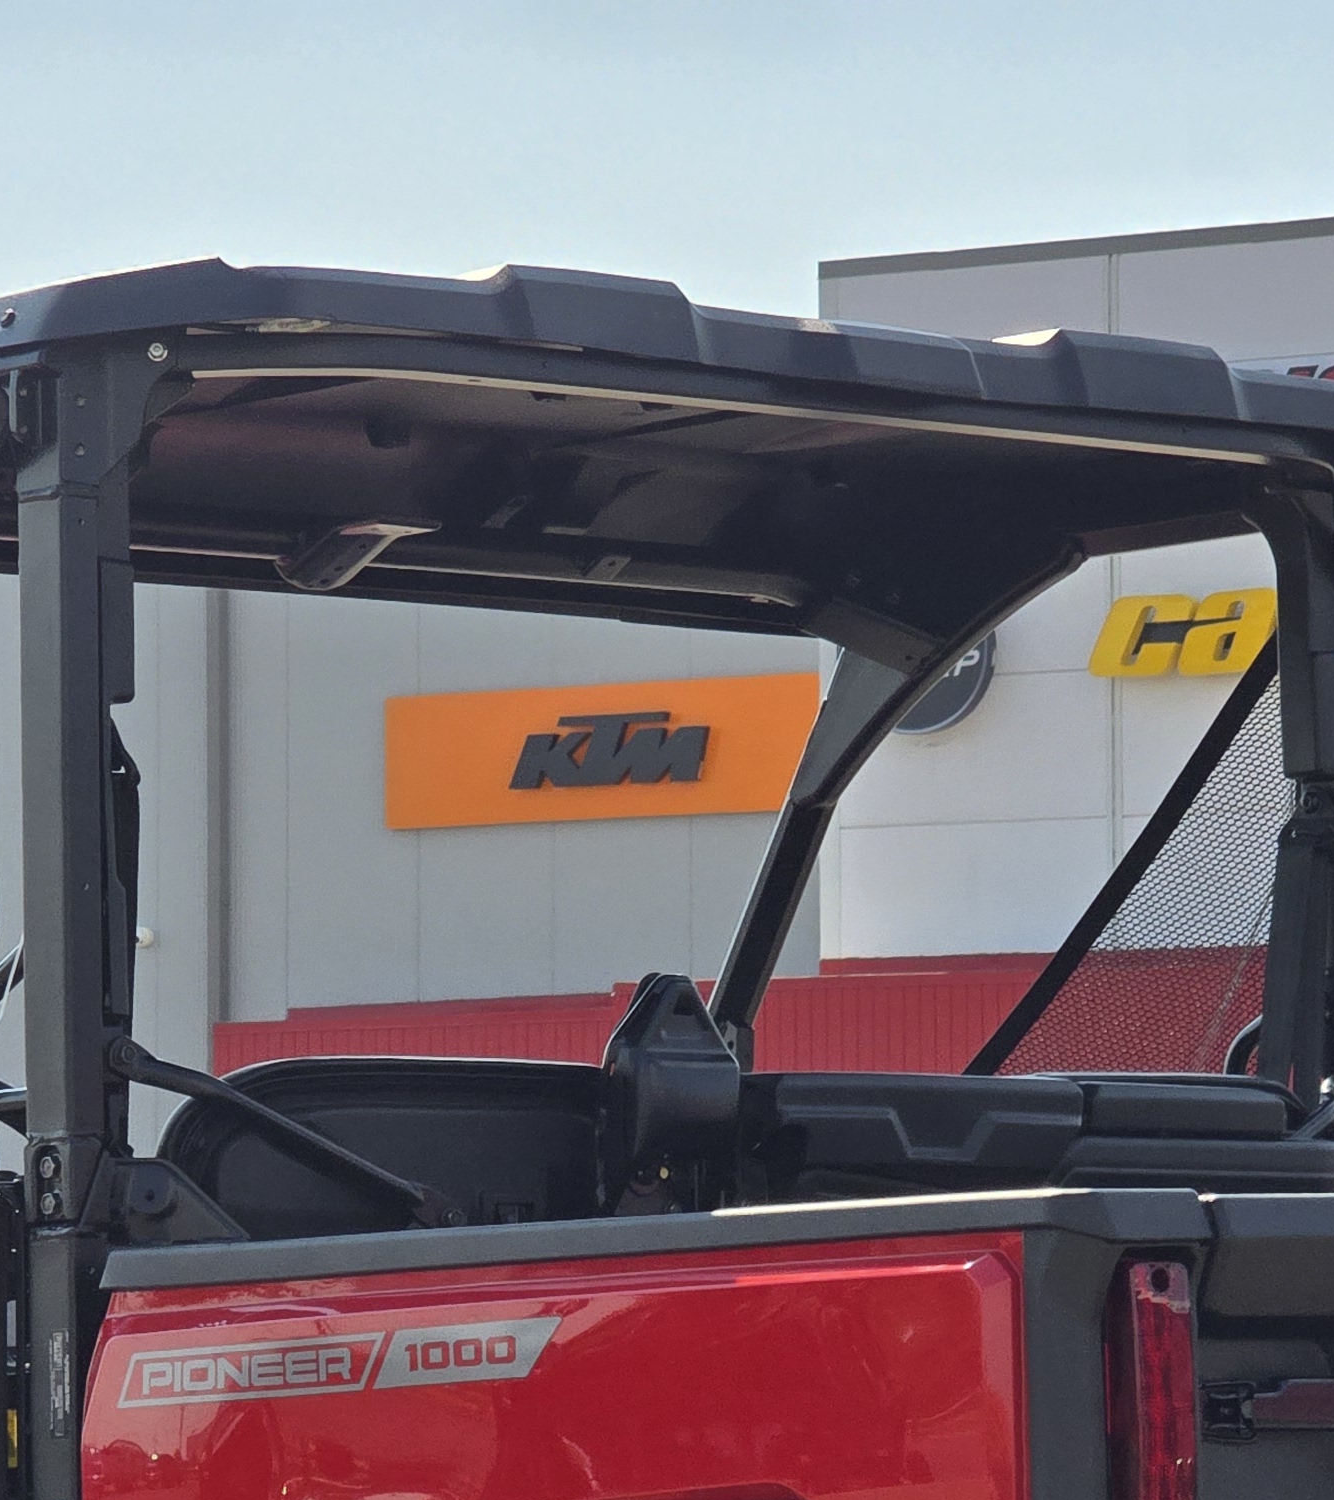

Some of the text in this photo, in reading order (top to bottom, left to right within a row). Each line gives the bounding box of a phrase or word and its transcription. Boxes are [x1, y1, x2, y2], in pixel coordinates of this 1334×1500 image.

[508, 710, 711, 790] KTM
[141, 1334, 517, 1395] PIONEER 1000
